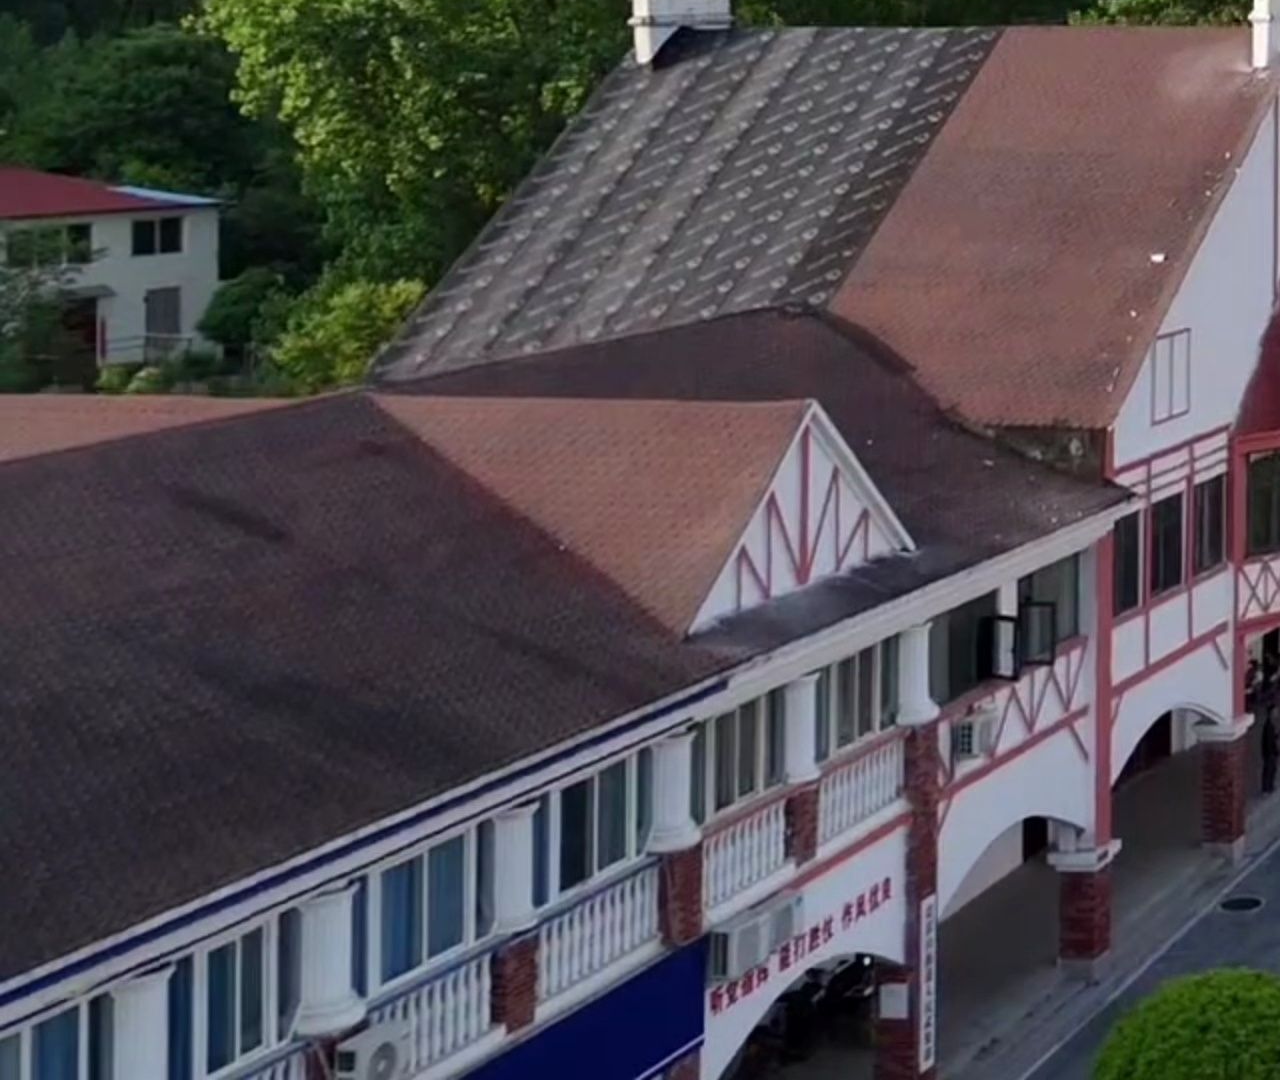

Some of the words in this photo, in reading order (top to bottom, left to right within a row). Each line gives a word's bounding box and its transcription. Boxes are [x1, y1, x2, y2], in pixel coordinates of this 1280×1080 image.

[779, 916, 834, 971] 能打胜仗
[841, 877, 892, 930] 作风优良
